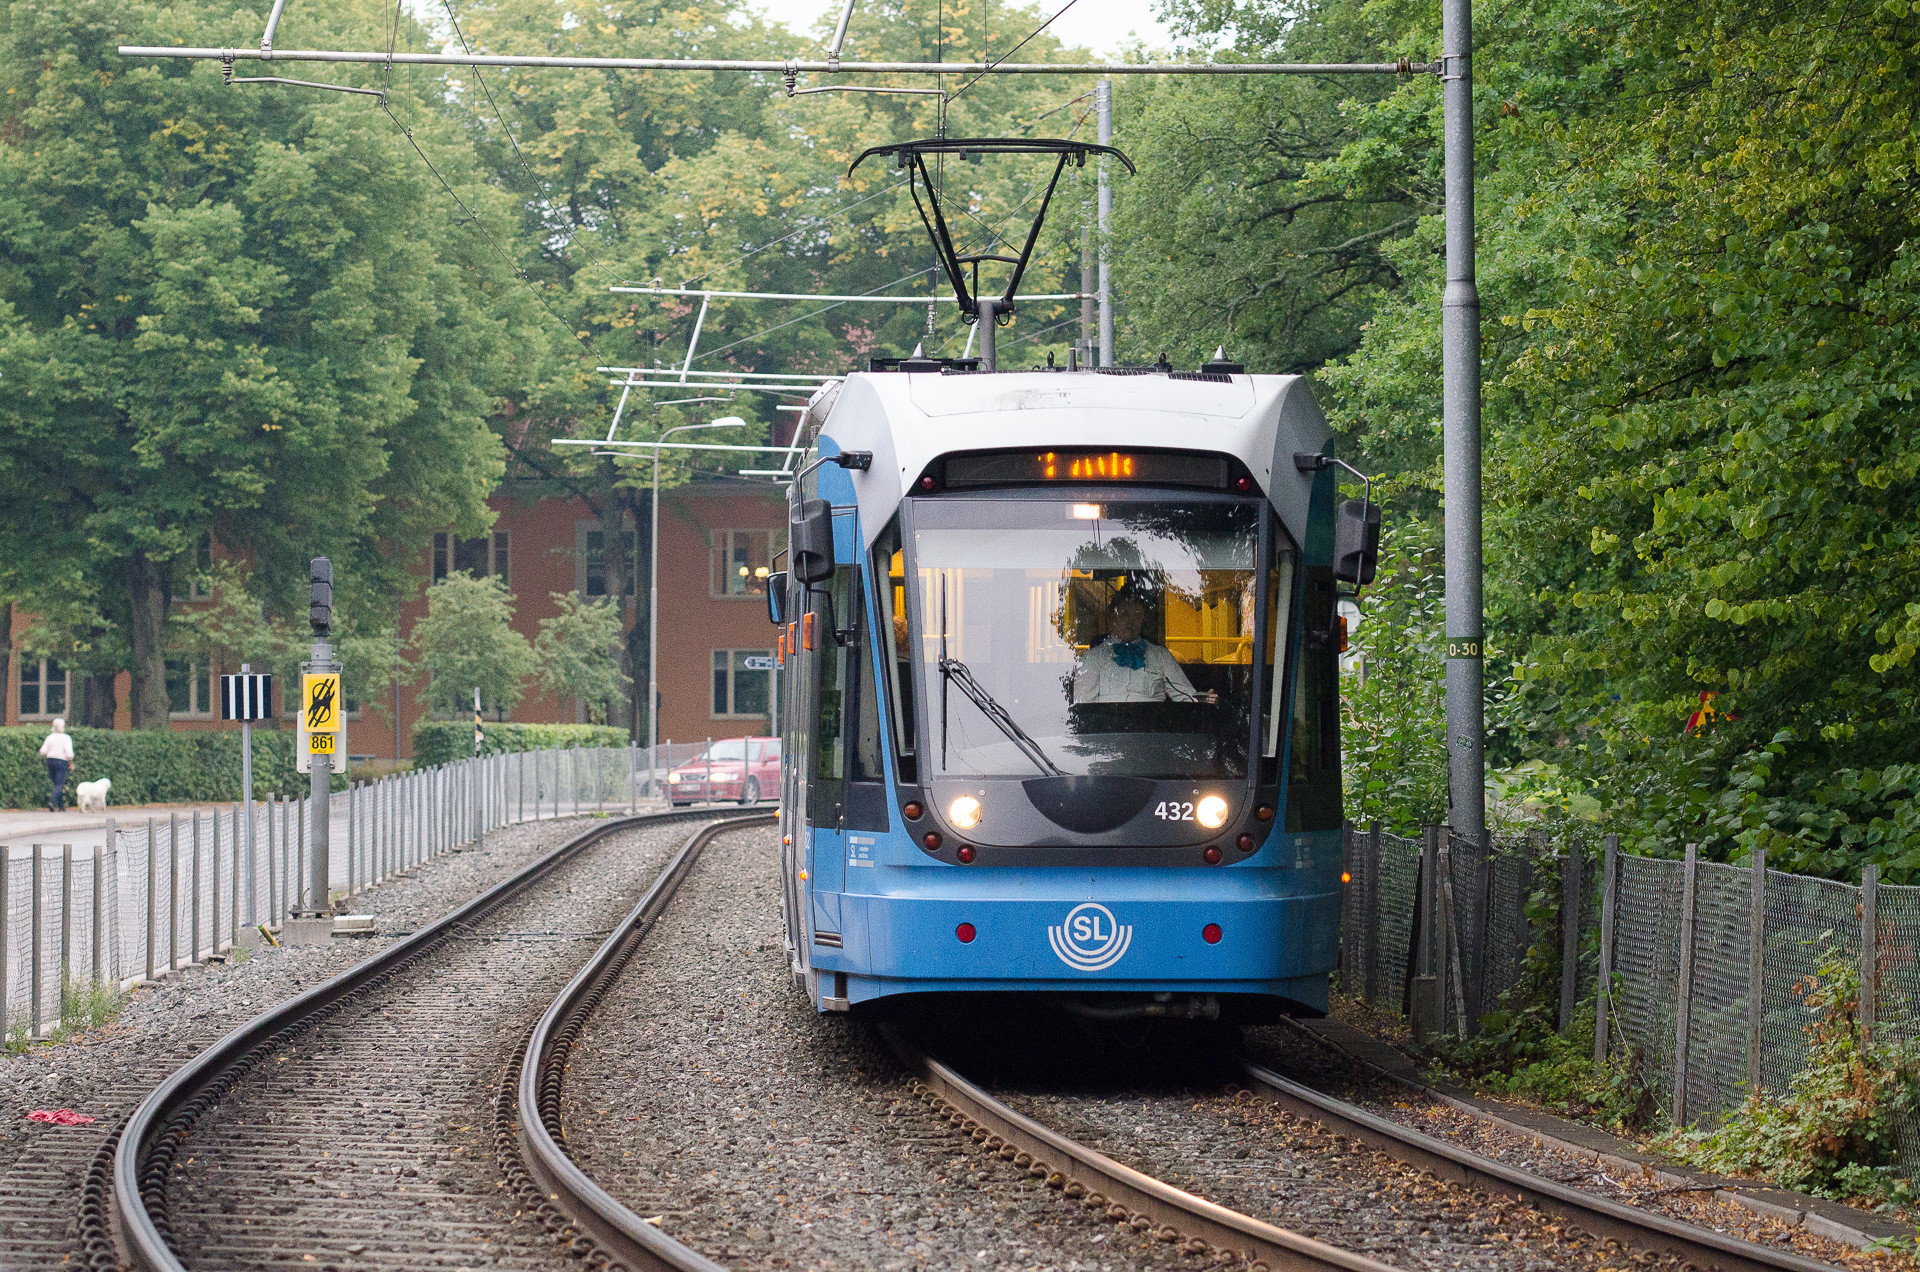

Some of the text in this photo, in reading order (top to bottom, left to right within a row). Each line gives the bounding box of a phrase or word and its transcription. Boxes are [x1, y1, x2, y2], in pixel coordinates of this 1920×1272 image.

[1450, 643, 1478, 656] 0-30
[312, 735, 333, 749] 861
[1154, 801, 1194, 821] 432
[1073, 915, 1109, 941] SL
